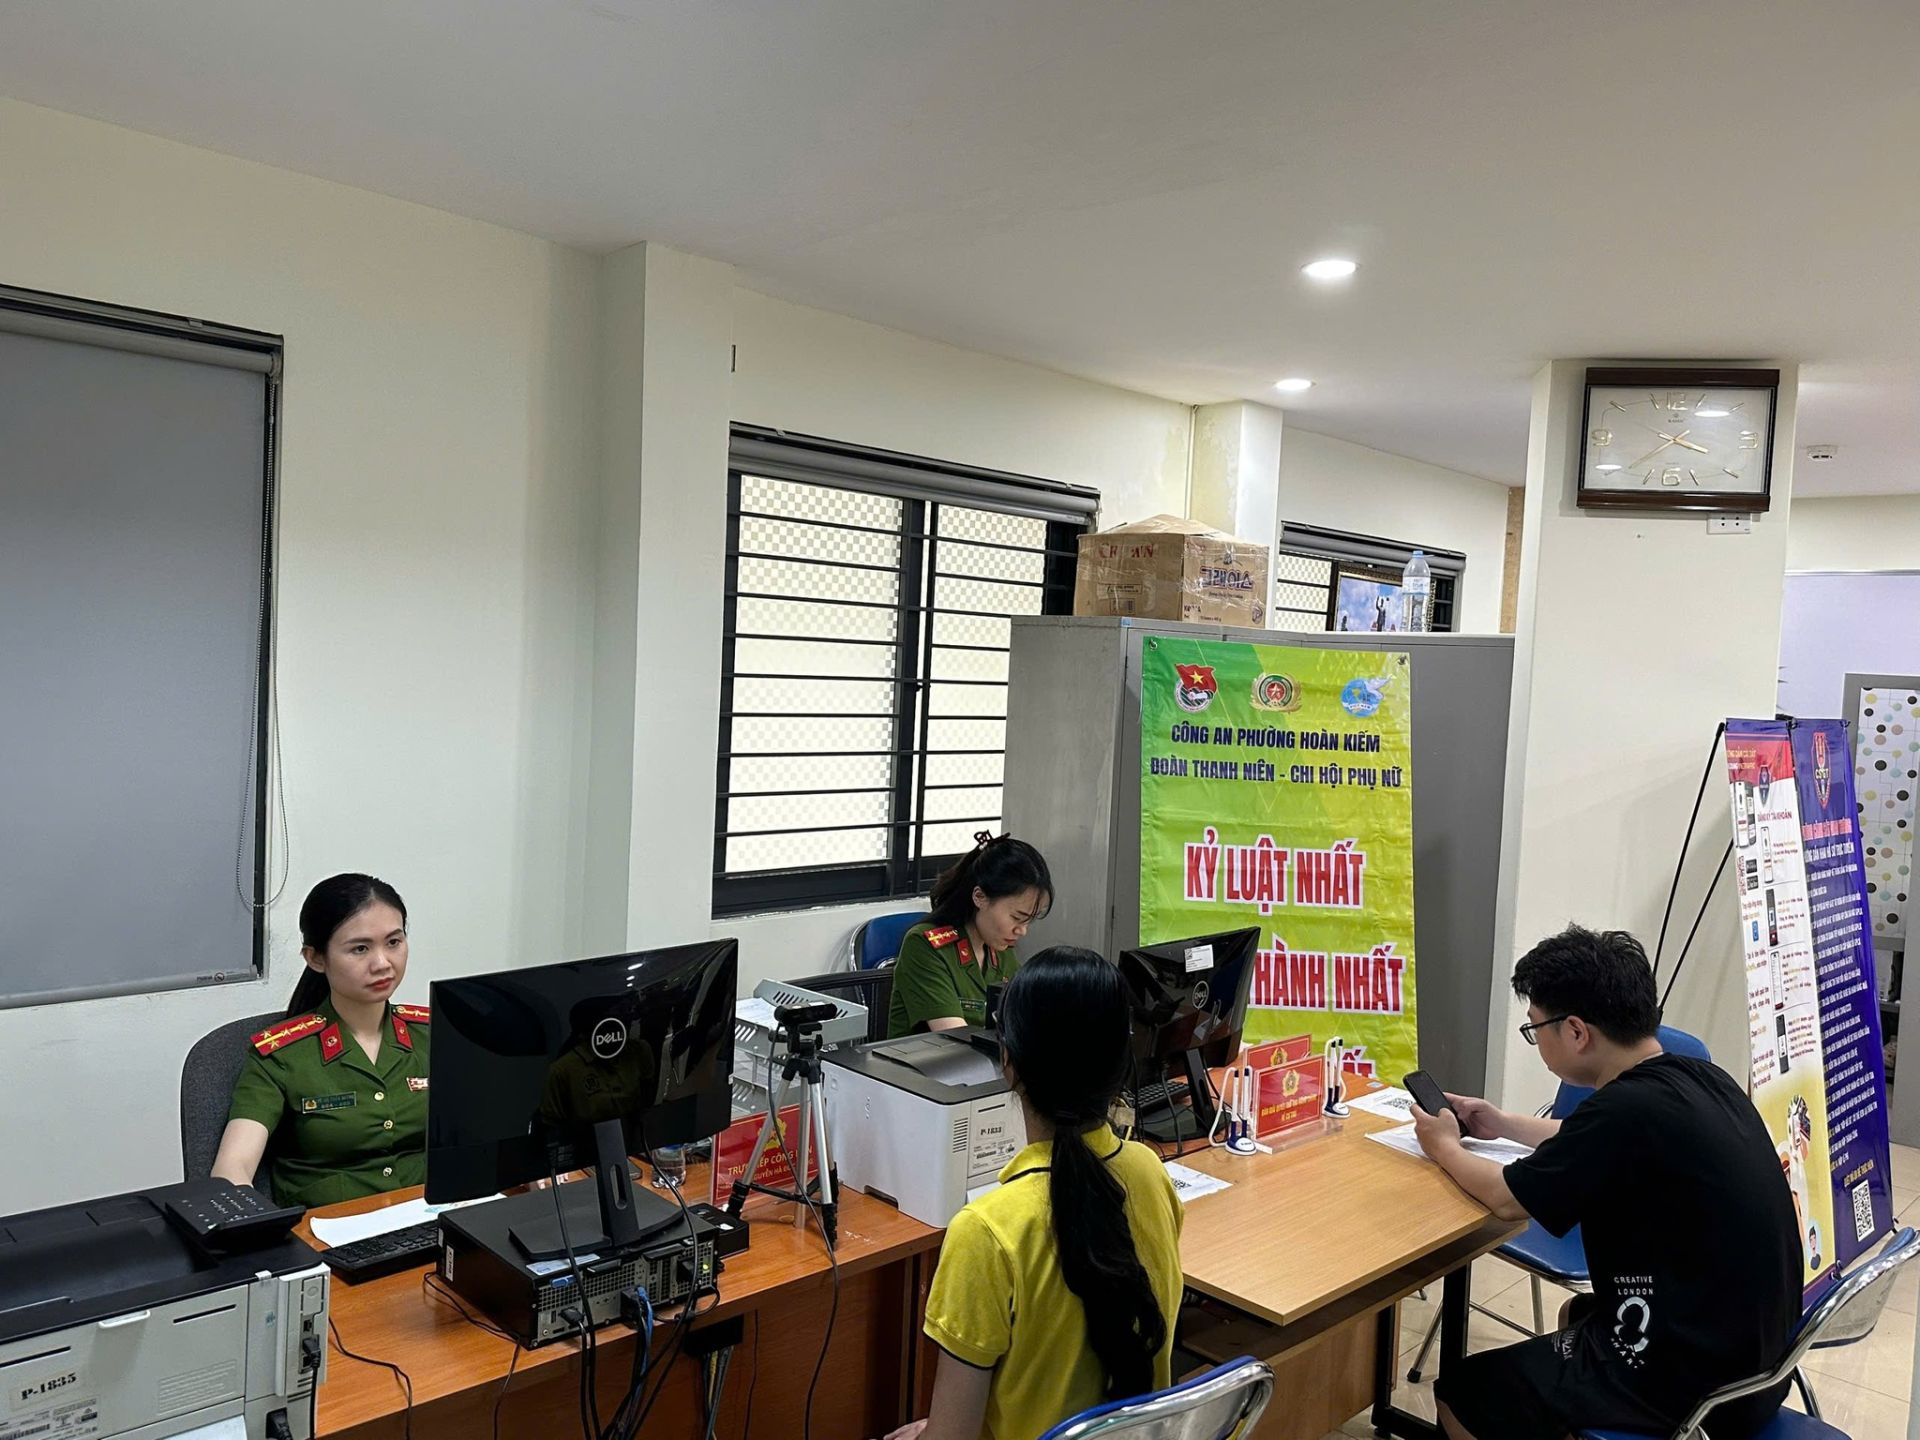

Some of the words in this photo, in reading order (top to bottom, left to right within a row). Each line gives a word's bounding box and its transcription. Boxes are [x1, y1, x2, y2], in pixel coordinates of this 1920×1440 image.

[1666, 391, 1688, 411] 12
[1591, 428, 1613, 447] 9
[1738, 429, 1759, 449] 3
[1661, 467, 1681, 486] 6
[1171, 721, 1209, 745] CÔNG
[1213, 727, 1232, 745] AN
[1237, 724, 1296, 749] PHƯỜNG
[1300, 729, 1339, 751] HOÀN
[1343, 730, 1381, 753] KIẾM
[1150, 756, 1188, 777] ĐOÀN
[1192, 760, 1238, 780] THANH
[1243, 758, 1275, 782] NIÊN
[1290, 765, 1315, 784] CHI
[1319, 763, 1343, 788] HỘI
[1348, 767, 1377, 790] PHỤ
[1381, 767, 1402, 787] NỮ
[1186, 828, 1220, 899] KỶ
[1225, 836, 1288, 913] LUẬT
[1295, 840, 1364, 906] NHẤT
[1254, 938, 1326, 1009] HÀNH
[1334, 945, 1403, 1012] NHẤT
[596, 1031, 623, 1046] DELL
[1614, 1276, 1653, 1284] CREATIVE
[1617, 1288, 1654, 1296] LONDON
[21, 1372, 77, 1400] P-1835
